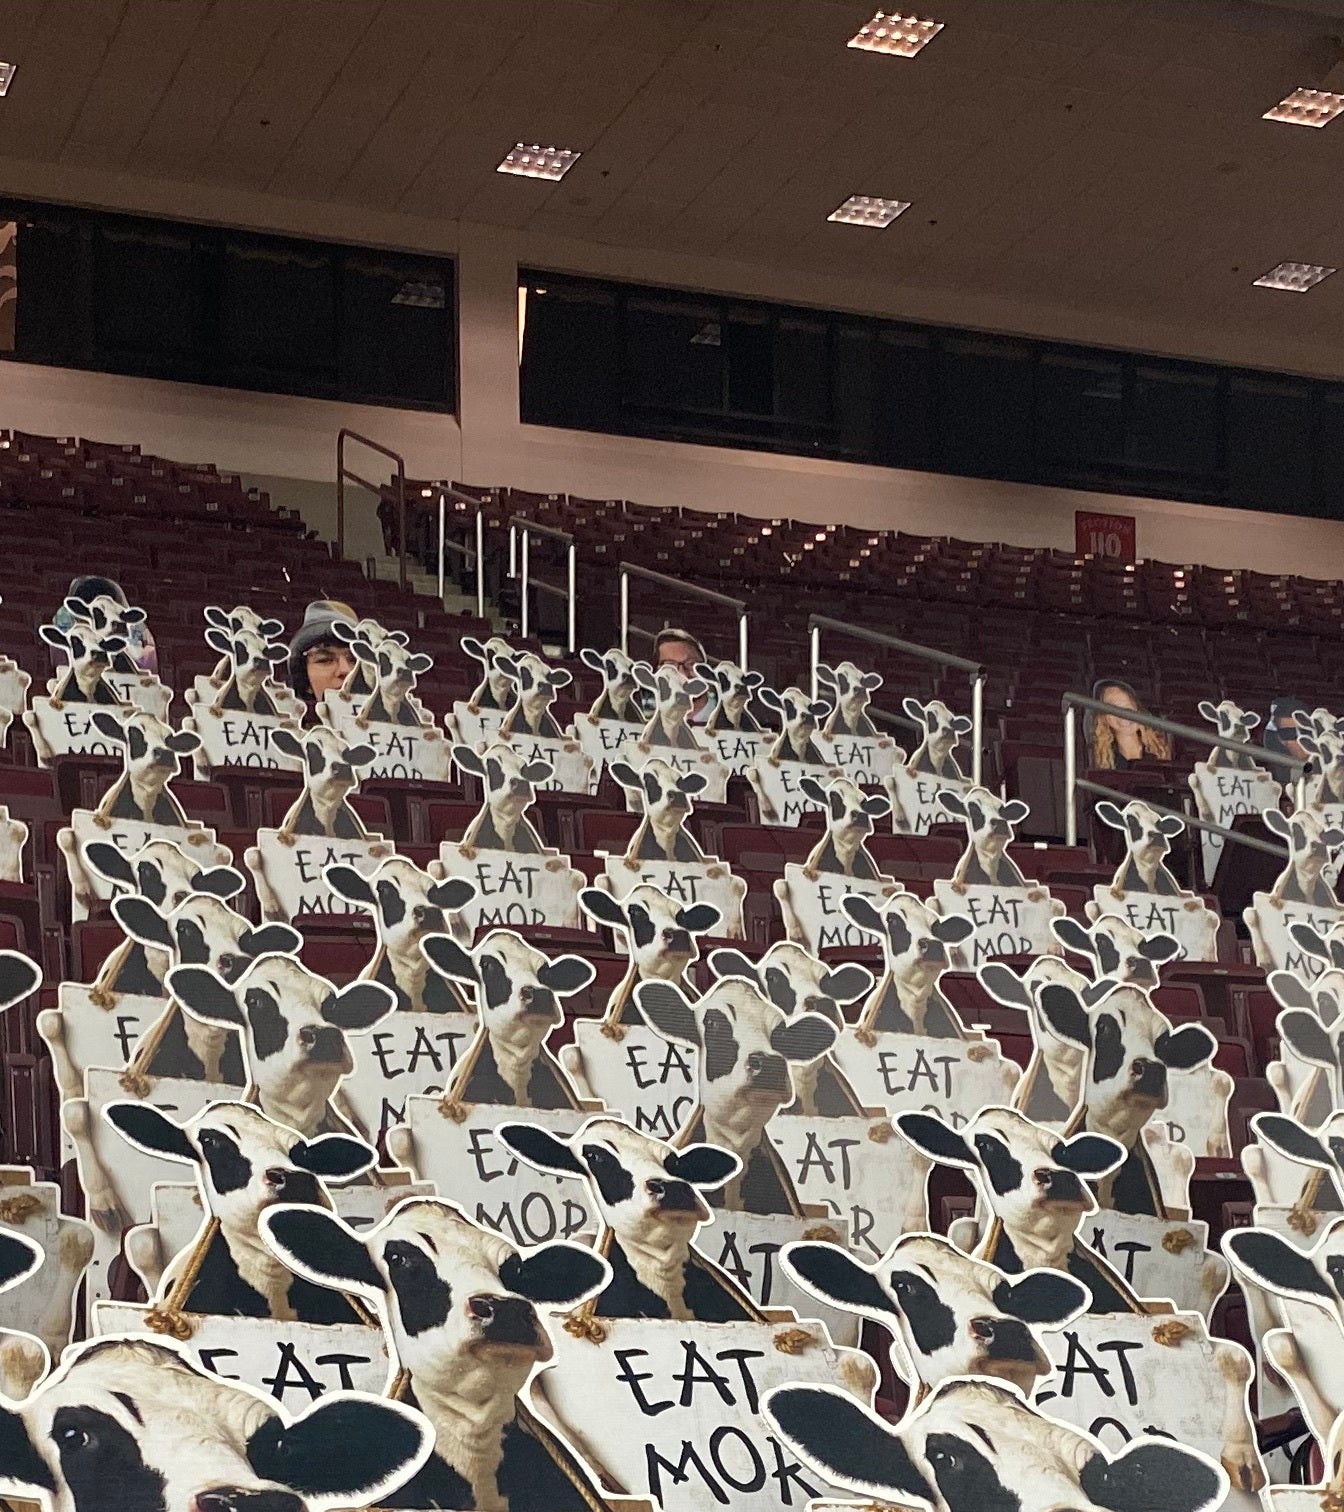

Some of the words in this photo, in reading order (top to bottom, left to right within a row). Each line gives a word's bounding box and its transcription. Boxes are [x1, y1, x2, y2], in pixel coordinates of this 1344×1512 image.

[222, 720, 274, 751] EAT
[718, 738, 759, 761] EAT
[670, 754, 696, 774] AT
[834, 743, 875, 767] EAT
[847, 769, 881, 785] OR
[1217, 776, 1255, 798] EAT
[784, 802, 825, 823] MO
[475, 861, 540, 895] EAT
[479, 903, 546, 926] MOR
[967, 894, 1024, 928] EAT
[1126, 903, 1180, 933] EAT
[973, 933, 1033, 967] MOR
[1285, 952, 1325, 980] MO
[372, 1026, 467, 1079] EAT
[626, 1044, 695, 1089] EA
[877, 1048, 961, 1098] EAT
[635, 1096, 694, 1138] MO
[774, 1132, 861, 1190] AT
[475, 1191, 588, 1245] MOR
[718, 1231, 782, 1306] AT
[614, 1340, 764, 1418] EAT
[1035, 1330, 1143, 1406] AT
